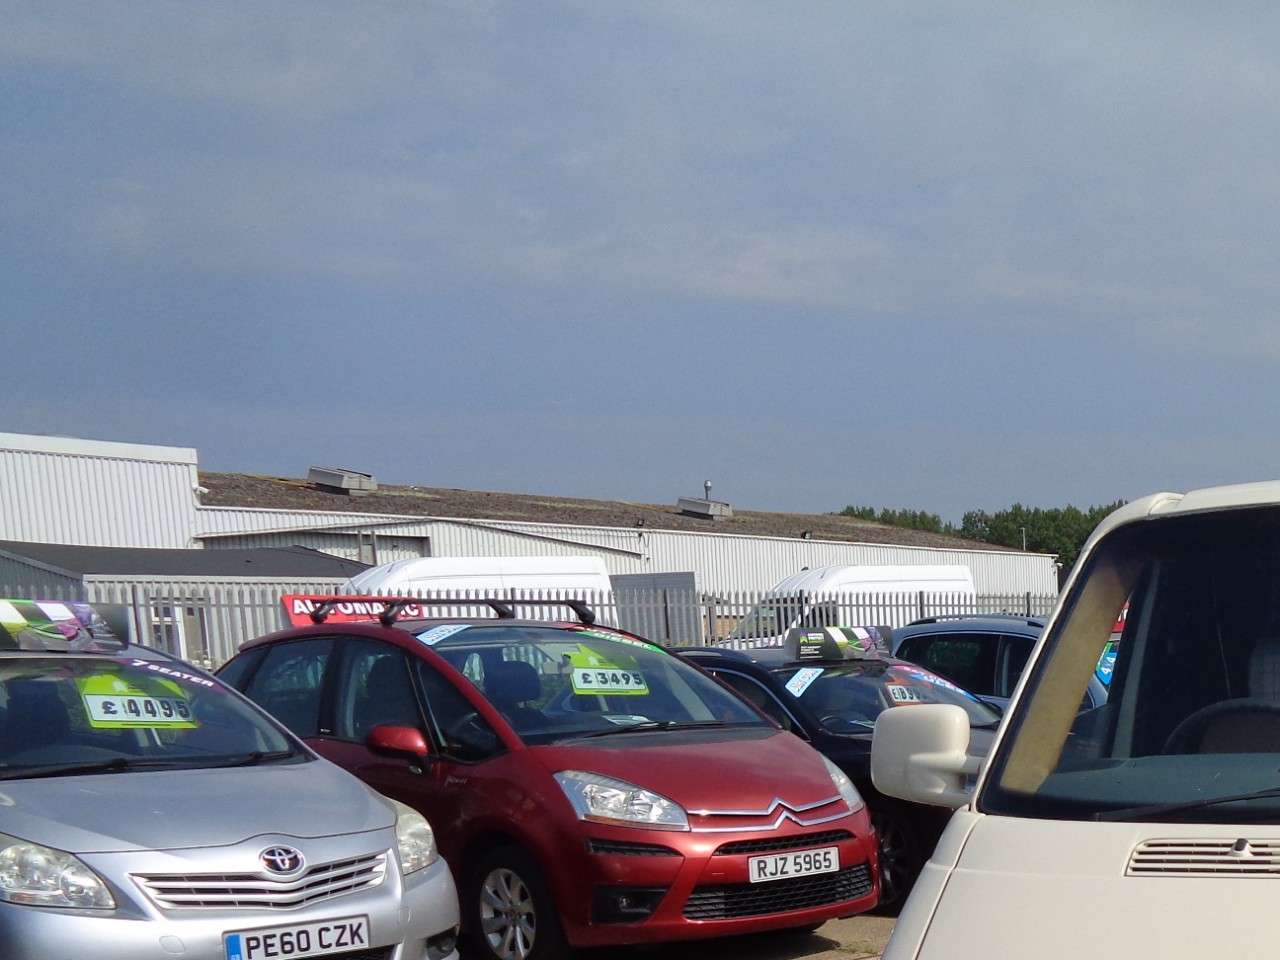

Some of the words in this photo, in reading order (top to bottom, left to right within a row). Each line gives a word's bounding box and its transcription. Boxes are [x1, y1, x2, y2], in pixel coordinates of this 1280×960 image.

[131, 659, 149, 667] 7
[147, 664, 215, 687] SEATER
[757, 856, 789, 878] RJZ
[793, 851, 833, 873] 5965
[245, 929, 311, 960] PE60
[317, 922, 365, 949] CZK
